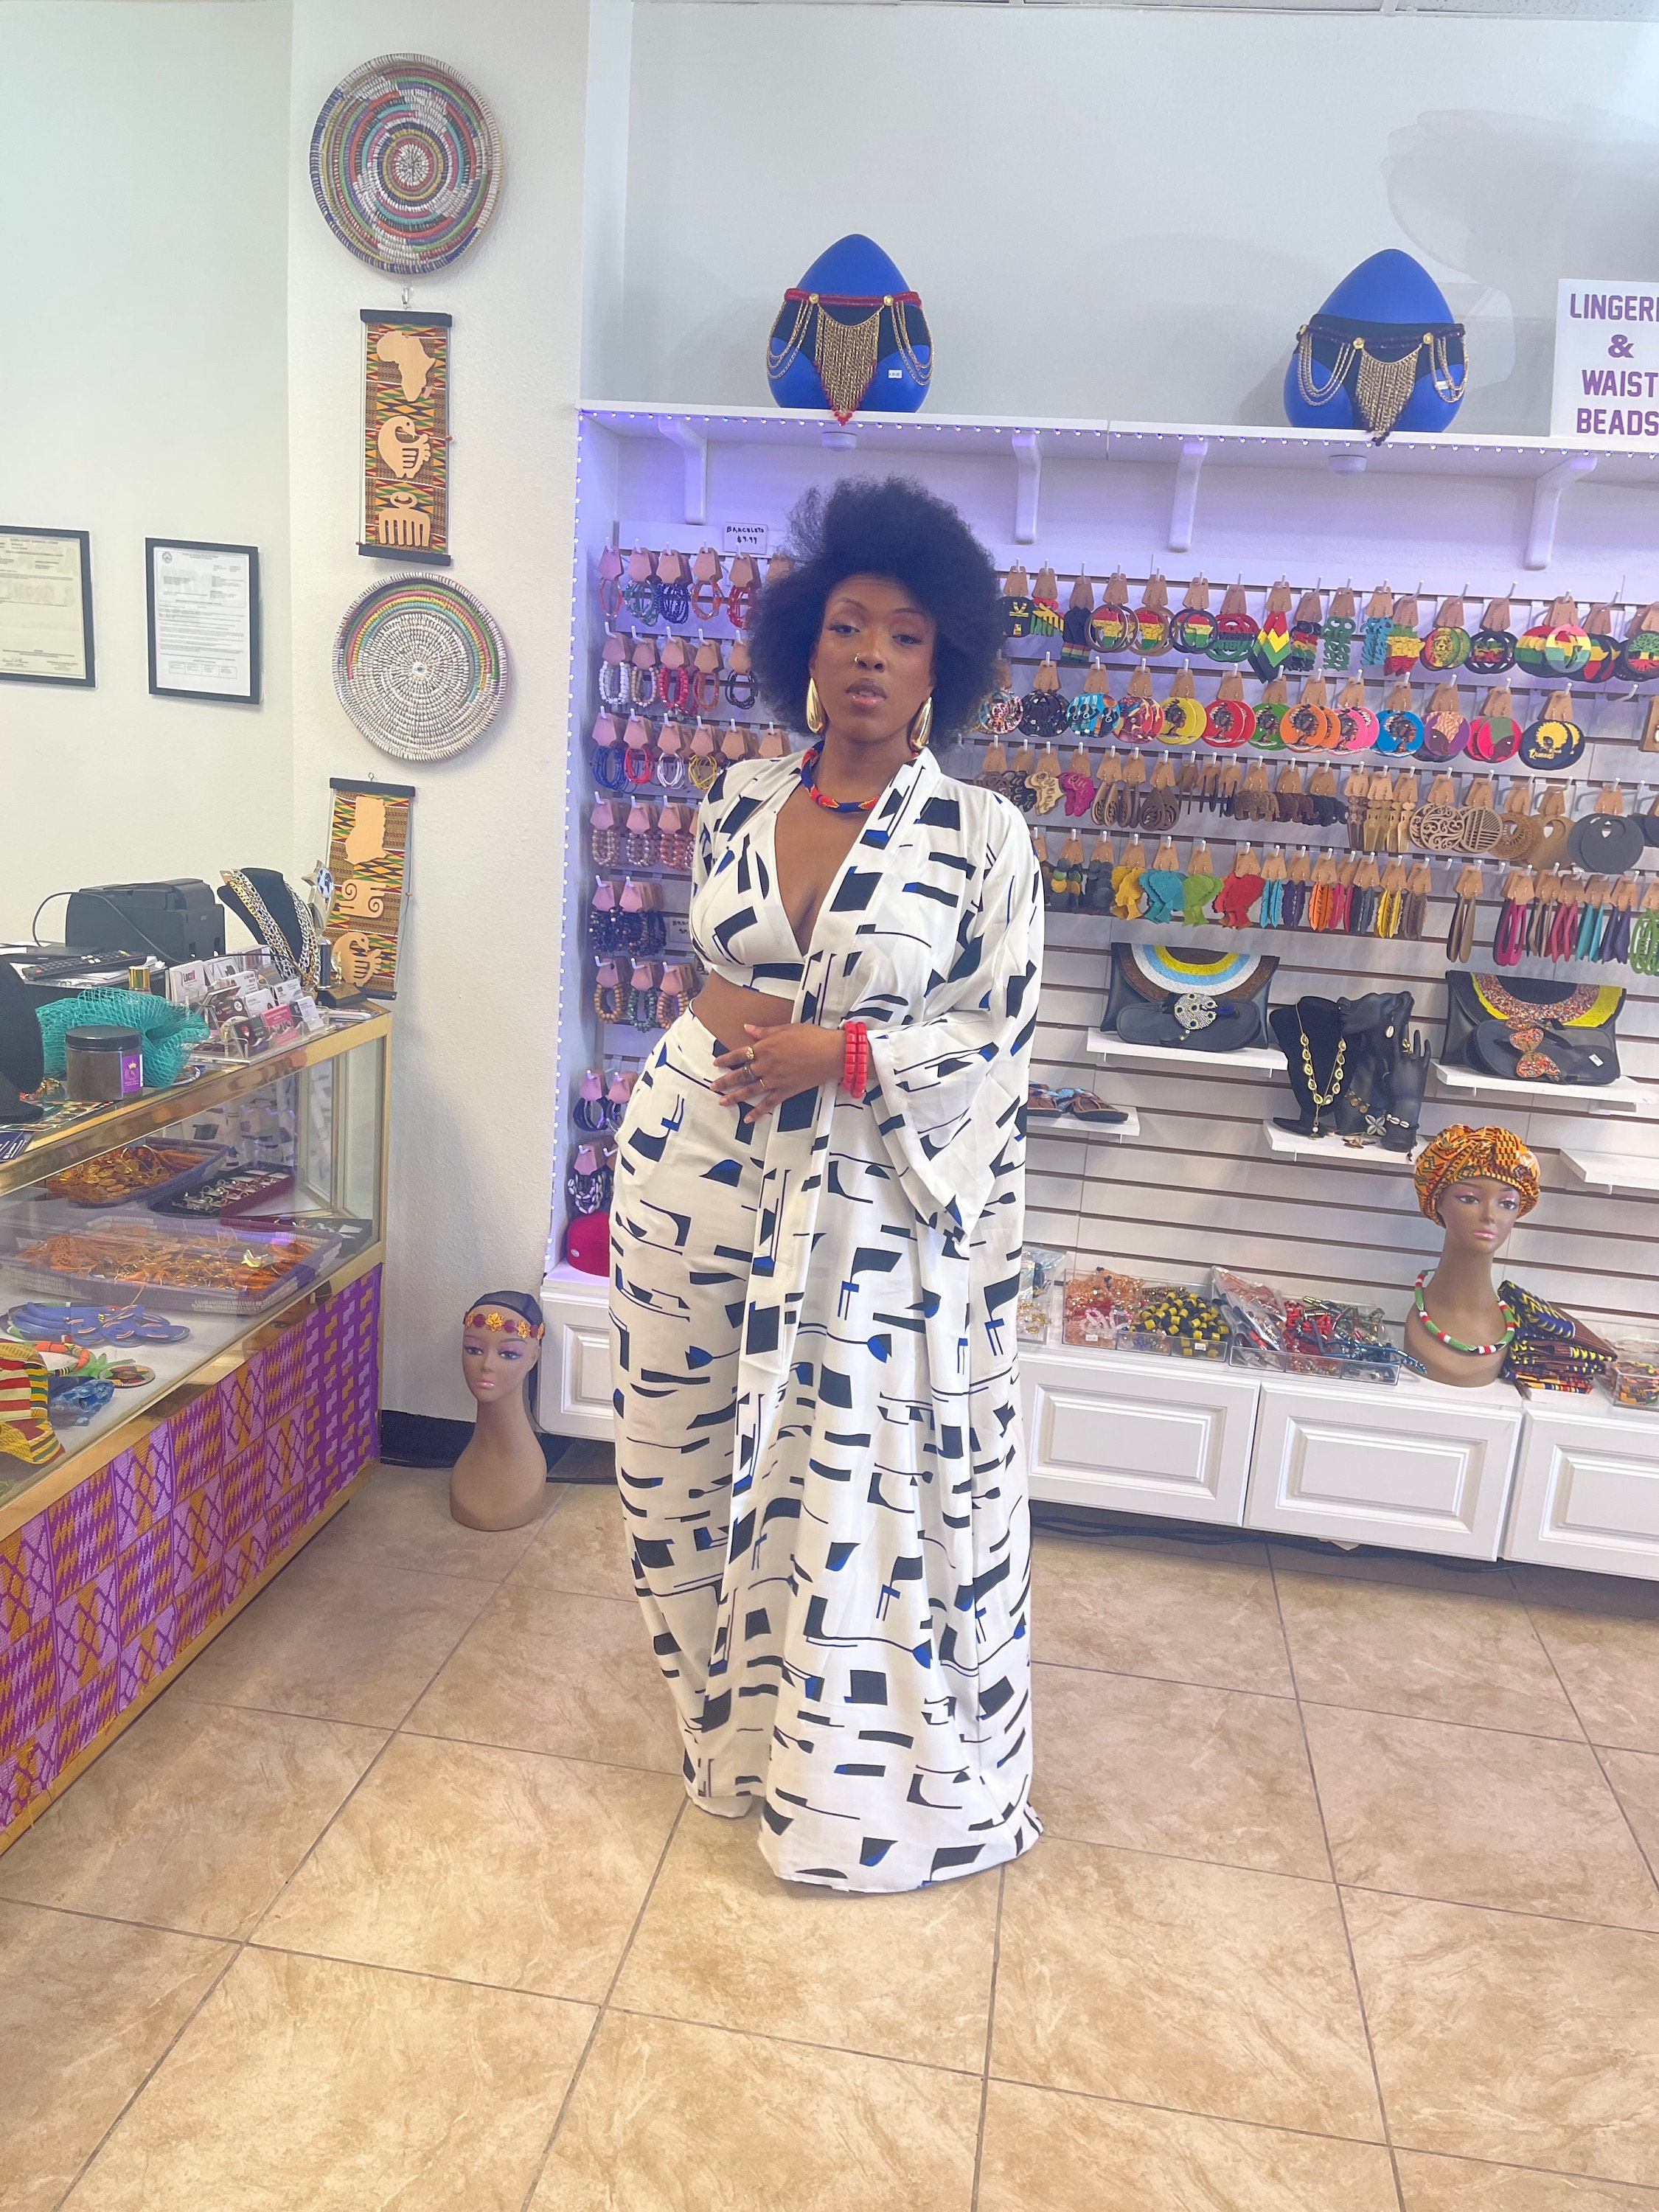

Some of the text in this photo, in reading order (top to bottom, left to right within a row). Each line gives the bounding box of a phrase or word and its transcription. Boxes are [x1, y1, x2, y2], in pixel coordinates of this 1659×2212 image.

[1607, 334, 1635, 358] &
[1582, 369, 1658, 397] WAIST
[1576, 408, 1659, 437] BEADS
